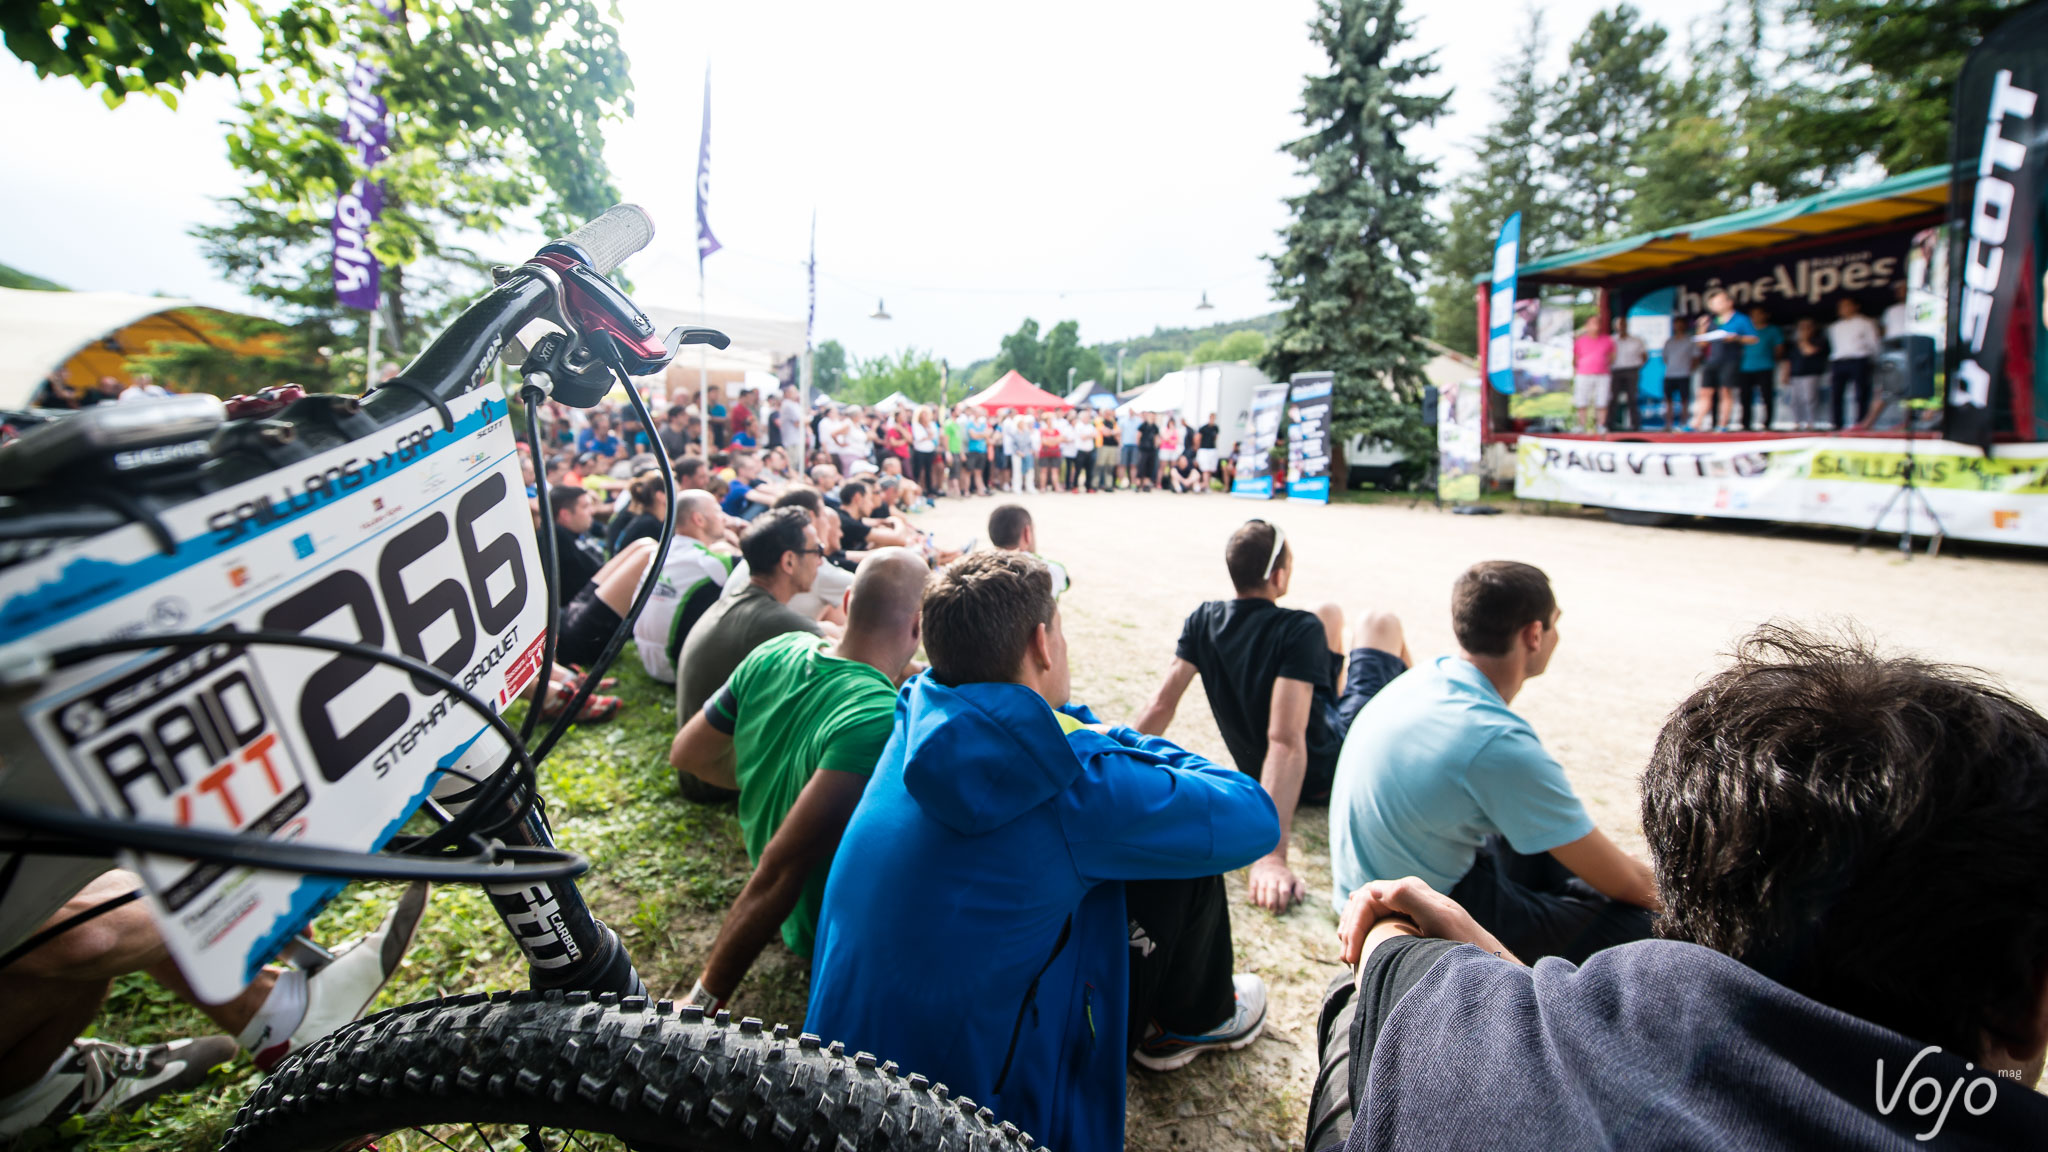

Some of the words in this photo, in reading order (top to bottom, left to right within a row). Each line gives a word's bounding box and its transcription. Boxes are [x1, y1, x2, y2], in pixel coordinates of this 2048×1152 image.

[1959, 69, 2038, 353] SCOTT
[539, 341, 556, 361] XTR
[476, 419, 504, 439] SCOTT
[1543, 447, 1616, 473] RAID
[1627, 452, 1715, 477] VTT
[261, 471, 528, 782] 266
[528, 640, 548, 674] 11
[97, 669, 268, 821] RAID
[550, 912, 583, 961] CARBON
